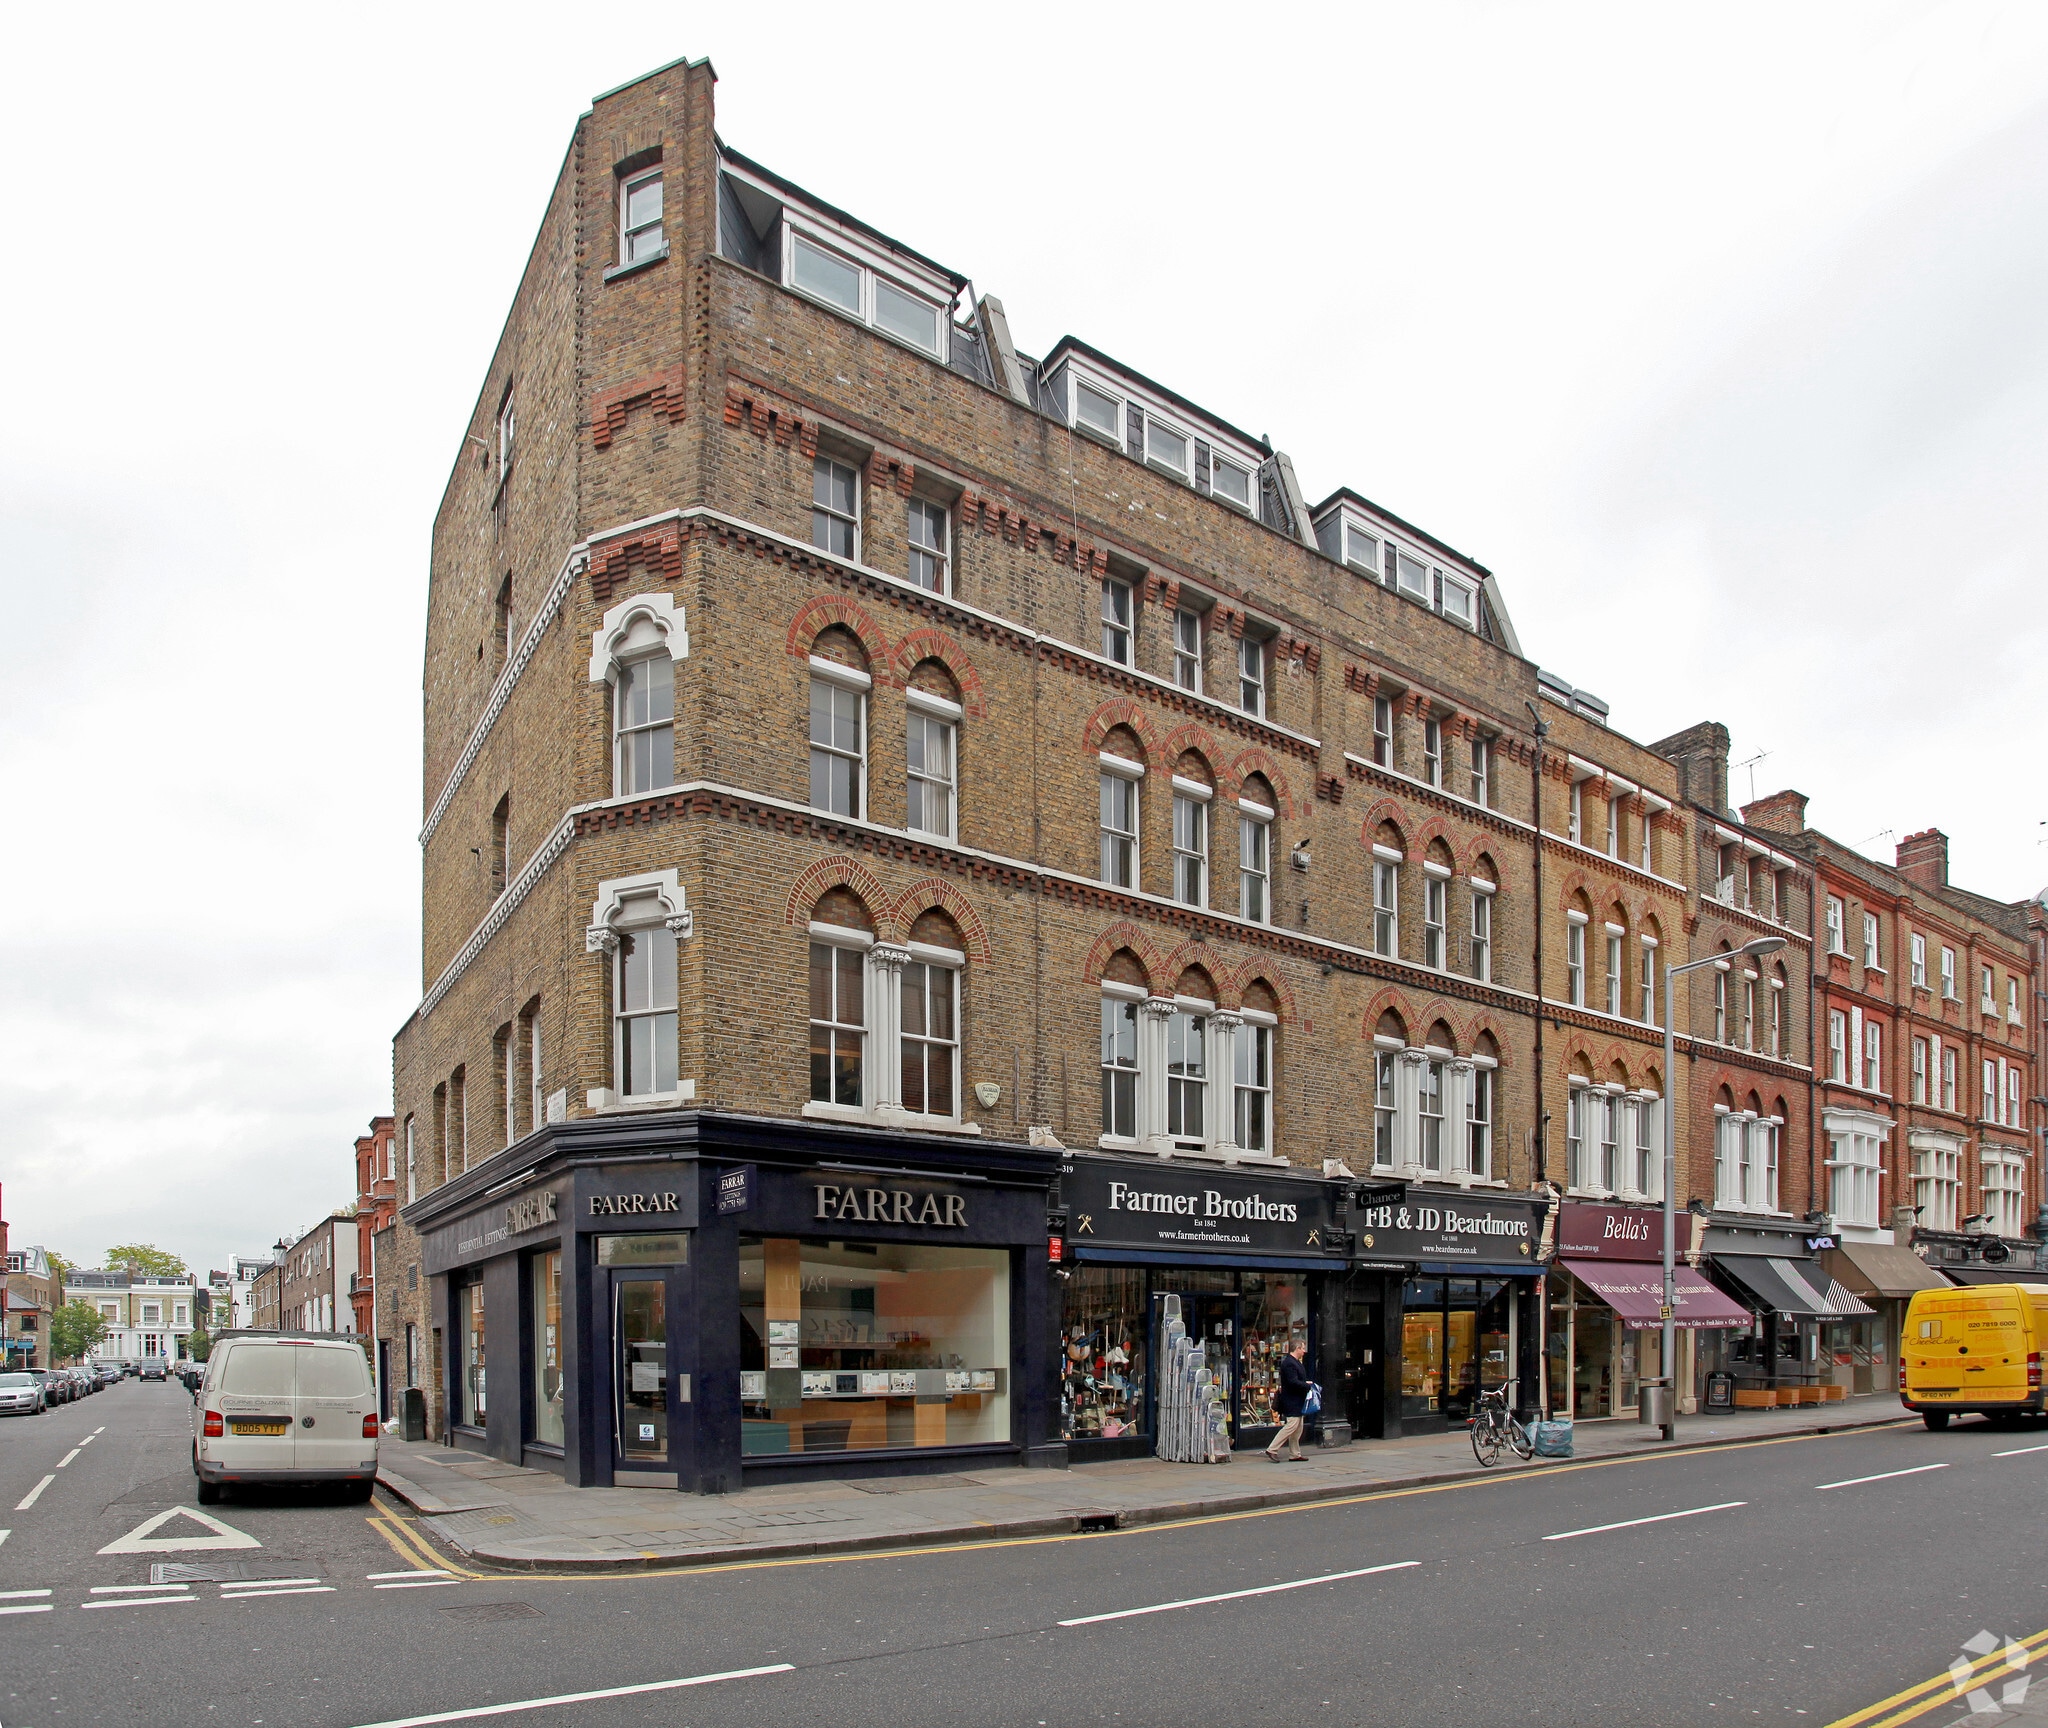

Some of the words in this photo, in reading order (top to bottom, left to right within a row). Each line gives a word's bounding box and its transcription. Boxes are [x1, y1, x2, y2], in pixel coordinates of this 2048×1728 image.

[1062, 1165, 1074, 1173] 319
[721, 1175, 745, 1190] FARRAR
[588, 1192, 680, 1215] FARRAR
[814, 1184, 969, 1227] FARRAR
[1108, 1182, 1198, 1216] Farmer
[1203, 1190, 1298, 1222] Brothers
[1360, 1191, 1401, 1206] Chance
[506, 1191, 557, 1236] FARRAR
[1365, 1205, 1392, 1229] FB
[1396, 1207, 1413, 1230] &
[1415, 1208, 1441, 1231] JD
[1444, 1210, 1529, 1237] Beardmore
[1194, 1219, 1203, 1227] Est
[1204, 1219, 1217, 1228] 1842
[1603, 1215, 1649, 1240] Bella's
[1158, 1230, 1250, 1243] www.farmerbrothers.co.uk
[1806, 1237, 1835, 1250] VQ
[1422, 1244, 1478, 1254] www.beardmore.co.uk
[1674, 1285, 1714, 1294] estaurant
[1917, 1299, 2004, 1314] cheese
[1914, 1357, 1994, 1369] sauces
[236, 1424, 261, 1433] BD05
